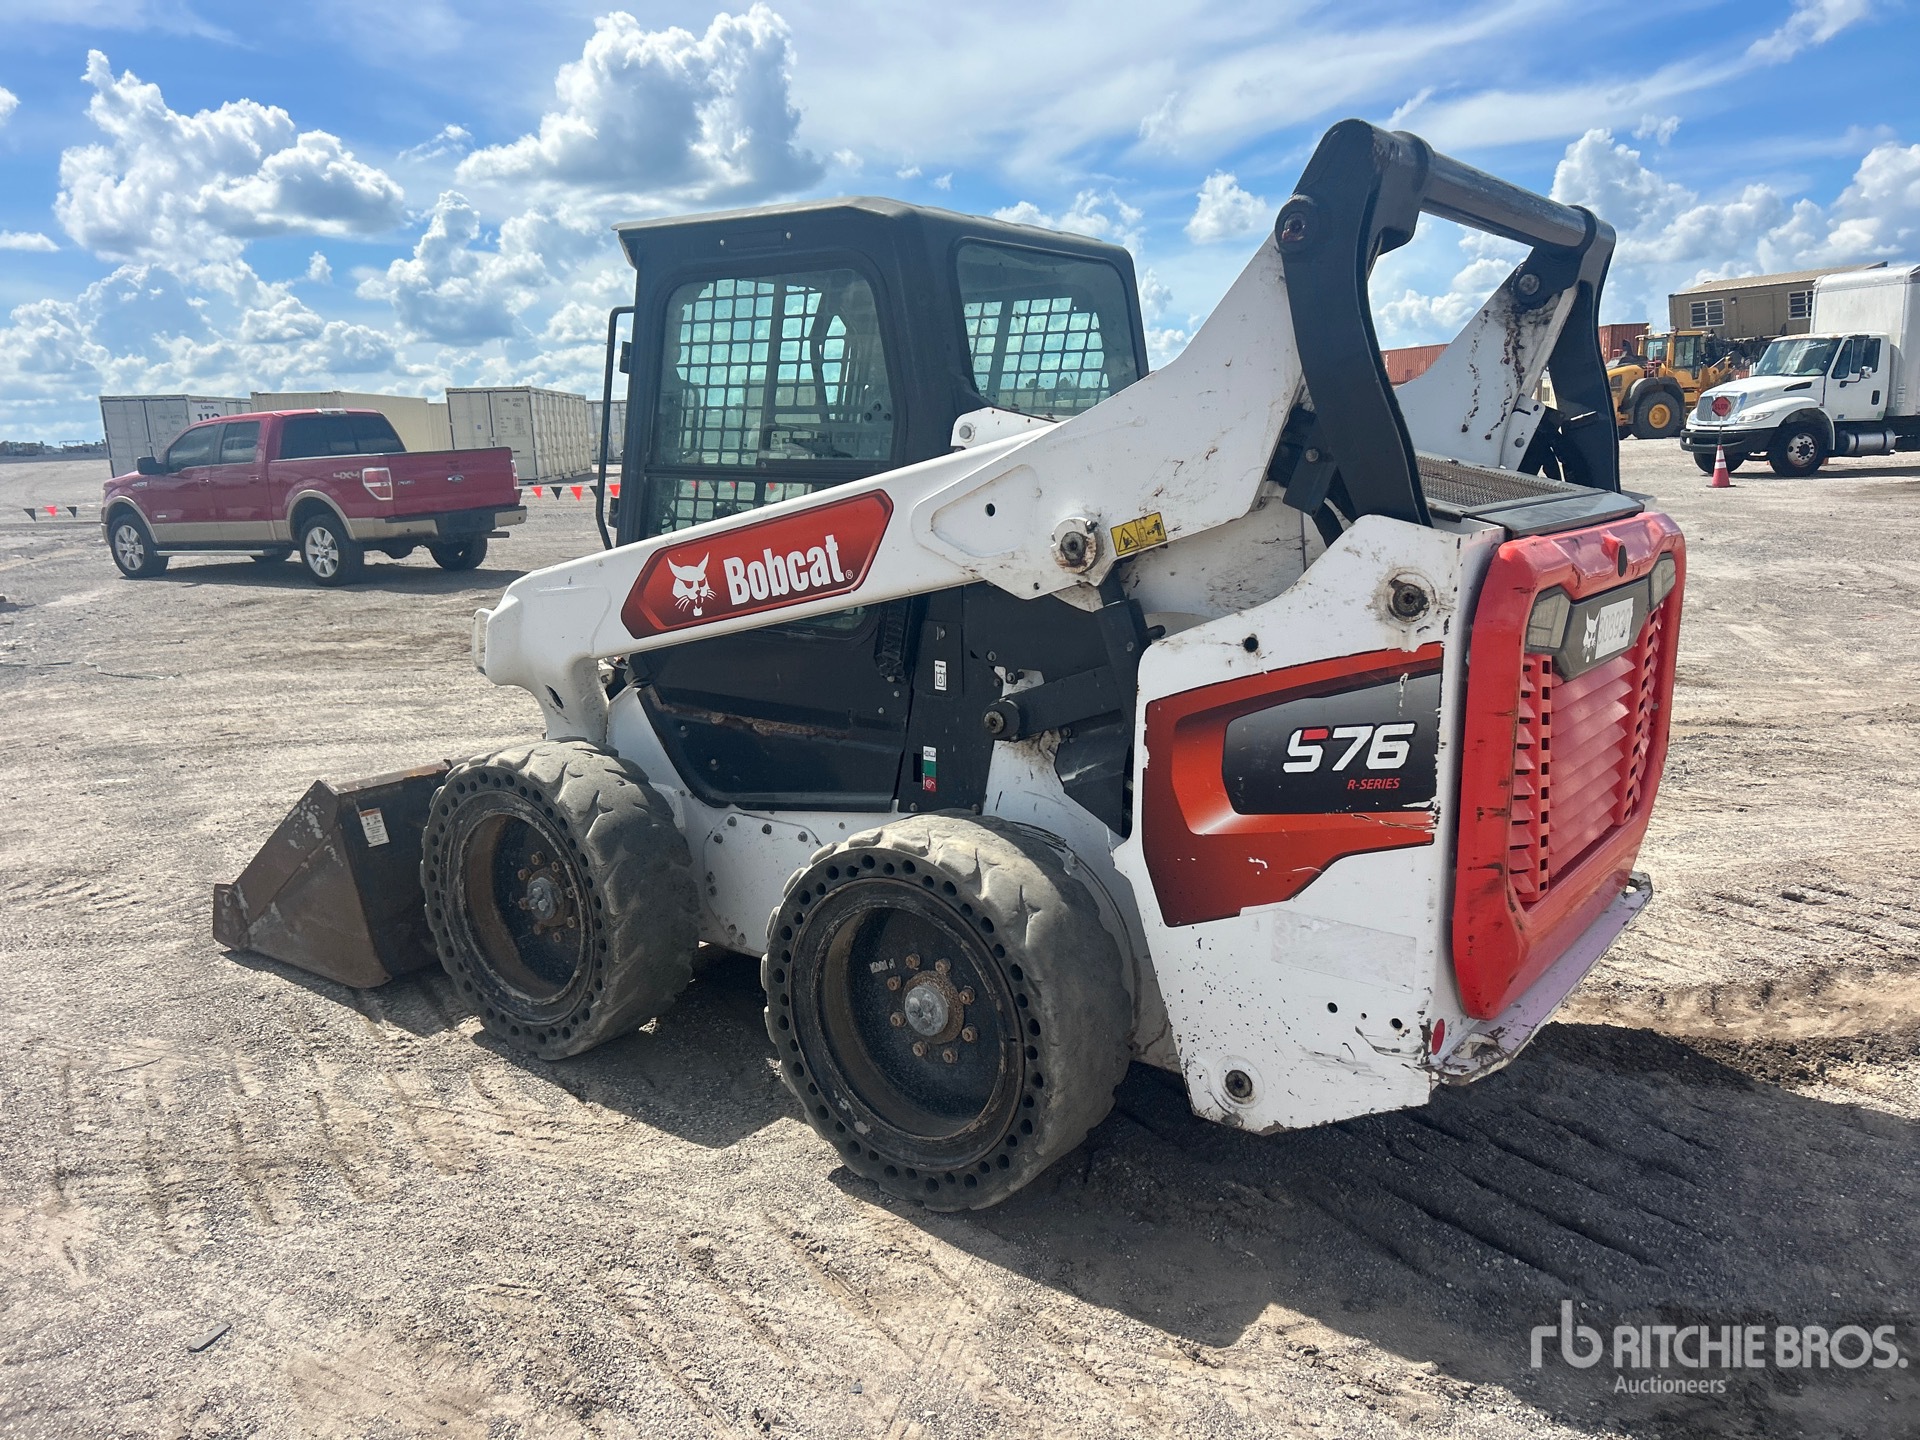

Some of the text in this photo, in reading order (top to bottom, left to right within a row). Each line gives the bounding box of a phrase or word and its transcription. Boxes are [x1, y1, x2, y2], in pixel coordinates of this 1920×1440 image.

[723, 534, 844, 605] Bobcat
[1283, 723, 1416, 773] S76
[1347, 778, 1400, 790] R-SERIES
